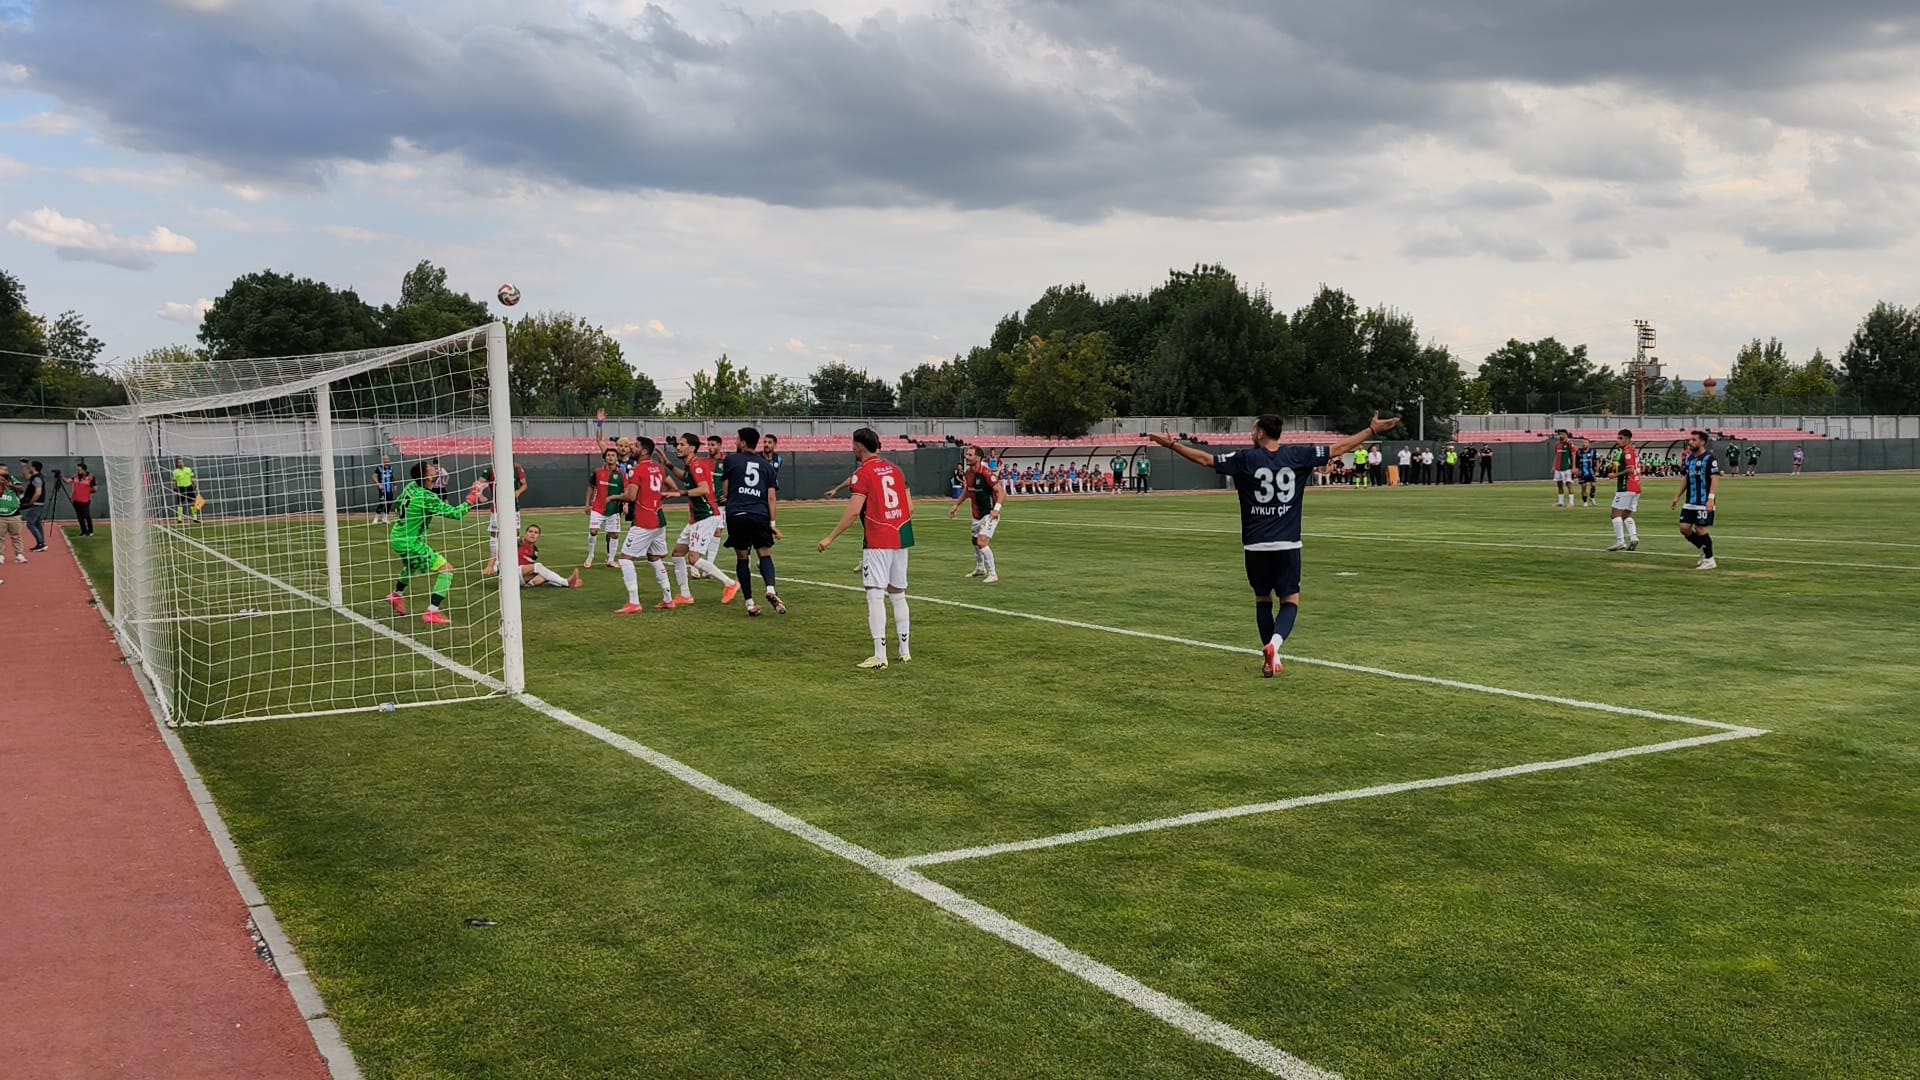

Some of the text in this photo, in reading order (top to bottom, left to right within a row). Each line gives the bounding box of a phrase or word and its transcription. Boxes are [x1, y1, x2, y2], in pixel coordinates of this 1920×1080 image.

[744, 461, 760, 487] 5
[738, 486, 761, 498] OKAN
[881, 475, 899, 509] 6
[1253, 466, 1297, 503] 39
[1250, 505, 1277, 516] AYKUT
[1696, 510, 1708, 519] 30
